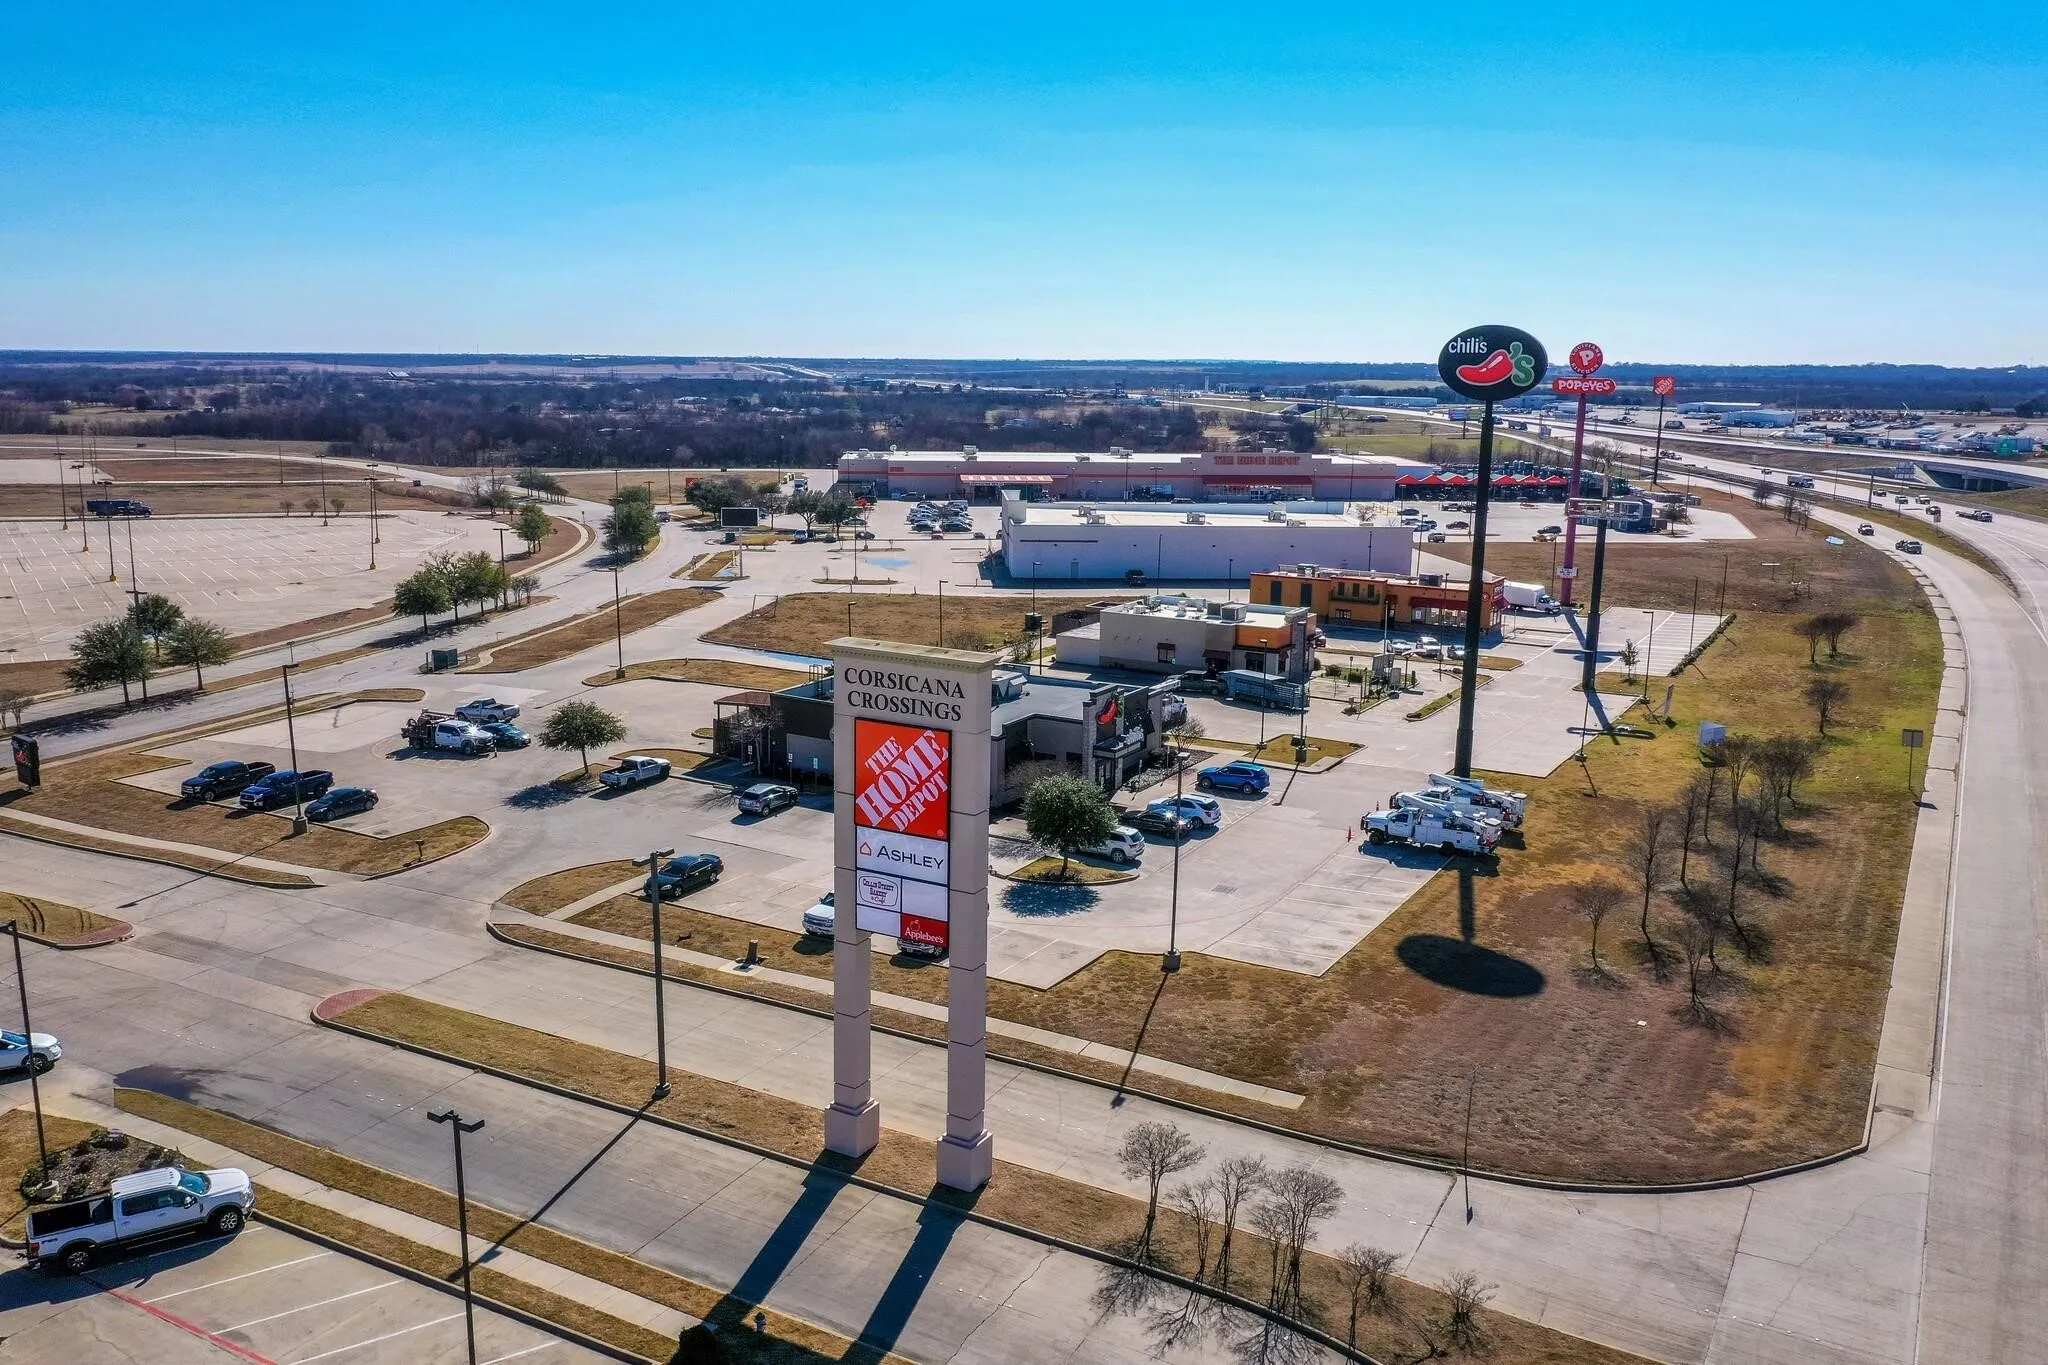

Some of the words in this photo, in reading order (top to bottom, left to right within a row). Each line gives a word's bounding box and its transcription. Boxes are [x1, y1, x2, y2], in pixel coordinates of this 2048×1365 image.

[1448, 336, 1488, 354] chili's
[844, 667, 965, 699] CORSICANA
[847, 690, 962, 722] CROSSINGS
[865, 736, 904, 776] THE
[855, 729, 950, 828] HOME
[889, 770, 950, 833] DEPOT
[876, 845, 945, 871] ASHLEY
[904, 927, 944, 944] Applebee's
